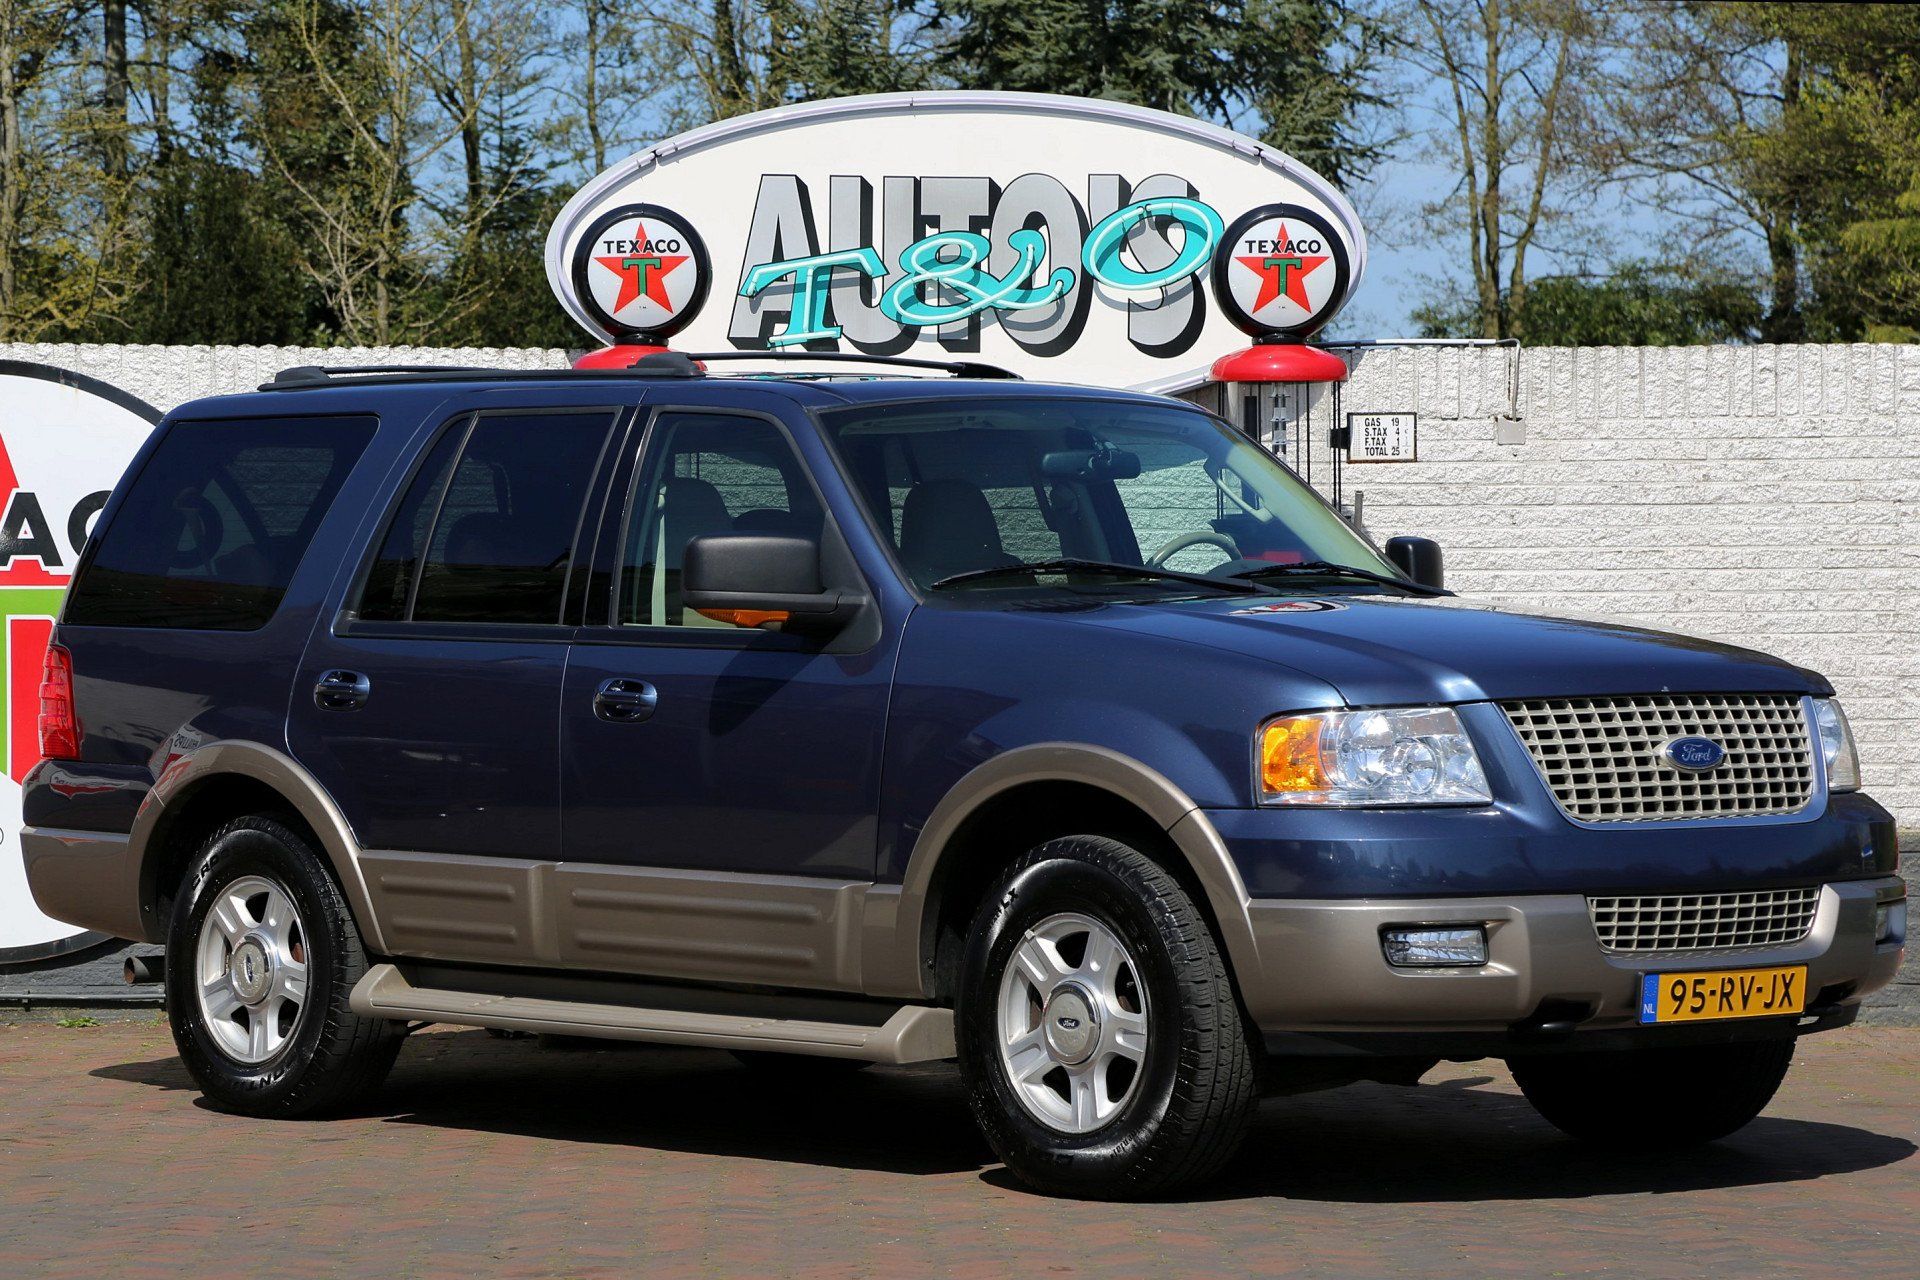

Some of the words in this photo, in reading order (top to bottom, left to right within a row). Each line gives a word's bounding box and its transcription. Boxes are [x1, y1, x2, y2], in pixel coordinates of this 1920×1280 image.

[603, 239, 681, 254] TEXACO
[1245, 239, 1322, 254] TEXACO
[727, 173, 1206, 358] AUTO'S
[622, 258, 661, 296] T
[1263, 258, 1302, 296] T
[1364, 417, 1381, 427] GAS
[1391, 417, 1400, 427] 19
[1364, 427, 1388, 437] S.TAX
[1395, 427, 1400, 436] 4
[1364, 437, 1387, 446] F.TAX
[1396, 437, 1400, 446] 1
[1364, 447, 1389, 456] TOTAL
[1391, 446, 1401, 456] 25
[1682, 743, 1712, 761] Ford
[1669, 972, 1796, 1015] 95-RV-JX
[1643, 1003, 1656, 1014] NL
